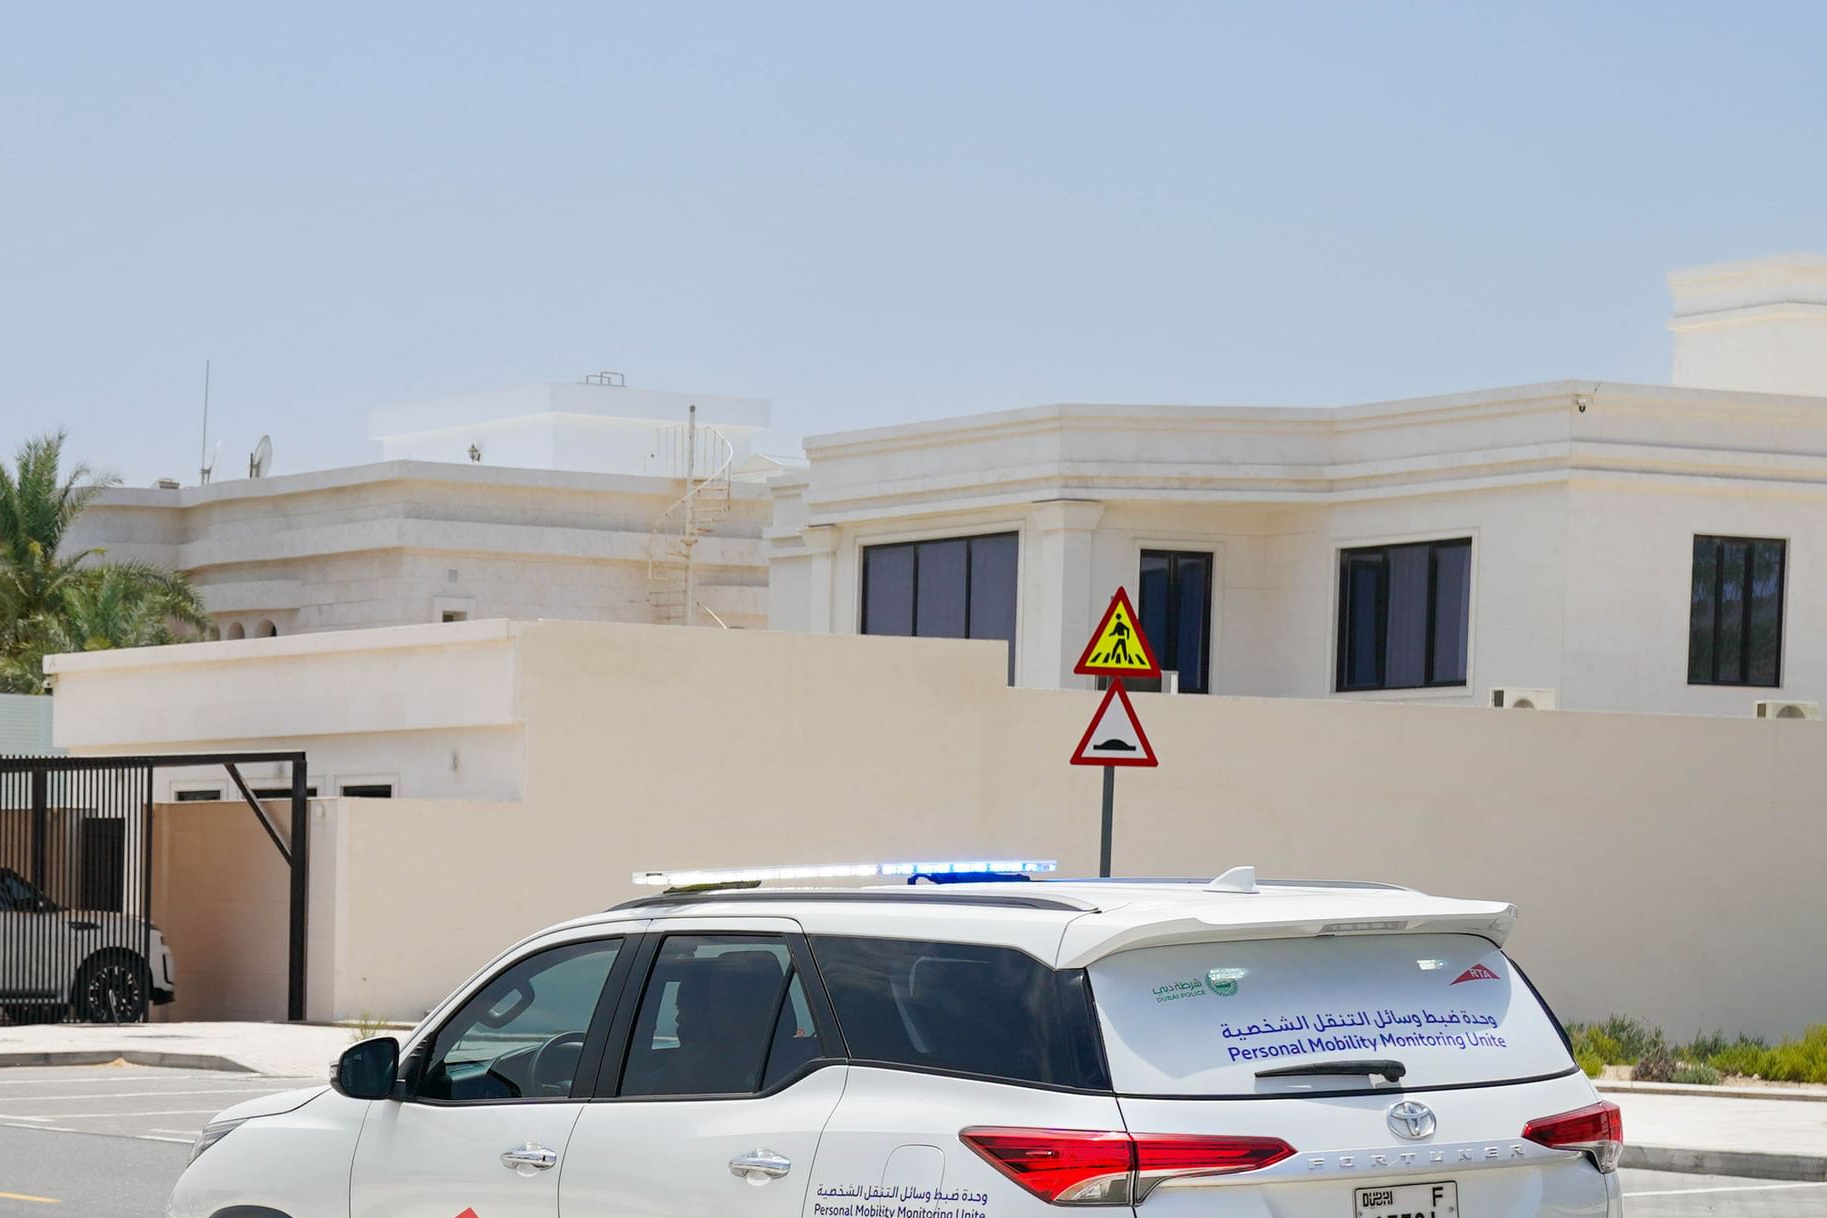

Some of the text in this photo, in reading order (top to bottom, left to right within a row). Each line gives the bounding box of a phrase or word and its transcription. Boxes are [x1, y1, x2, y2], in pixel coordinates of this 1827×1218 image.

[1469, 968, 1492, 979] RTA
[1156, 989, 1206, 1003] DUBAI POLICE
[1220, 1009, 1498, 1041] وحدة ضبط وسائل التنقل الشخصية
[1227, 1031, 1507, 1062] Personal Mobility Monitoring Unite
[1308, 1145, 1525, 1170] FORTUNER
[816, 1183, 988, 1206] وحدة ضبط وسائل التنقل الشخصية
[1432, 1186, 1444, 1208] F
[814, 1203, 853, 1217] Personal
[855, 1204, 895, 1218] Mobility
